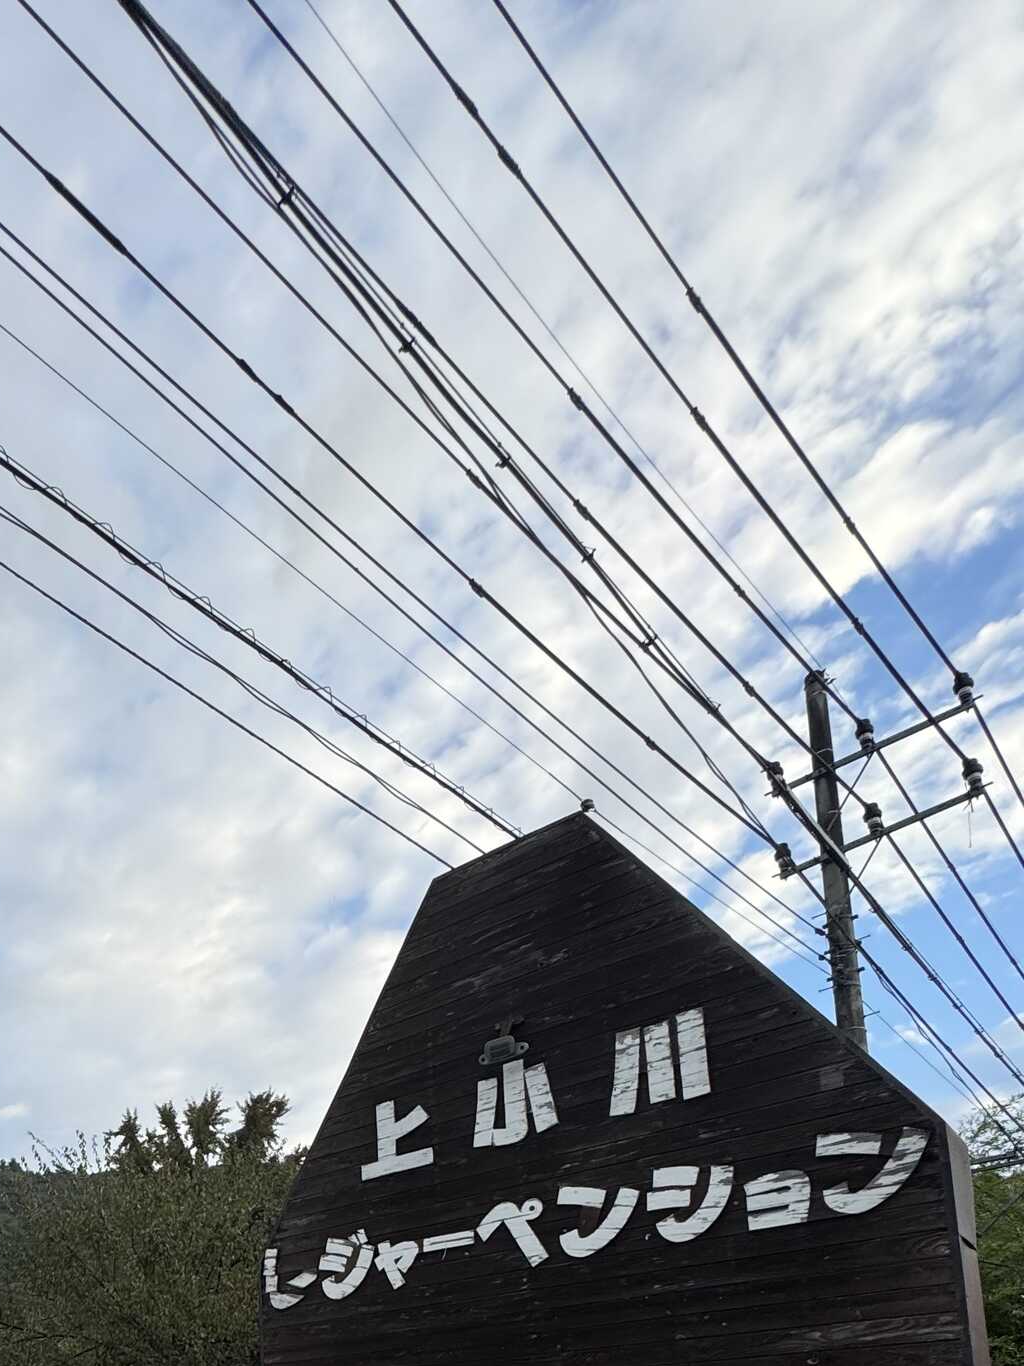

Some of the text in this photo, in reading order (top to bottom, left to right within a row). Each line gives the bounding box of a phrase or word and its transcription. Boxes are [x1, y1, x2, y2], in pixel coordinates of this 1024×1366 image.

[360, 1006, 713, 1182] 上小川
[264, 1126, 933, 1310] レジャーペンション
